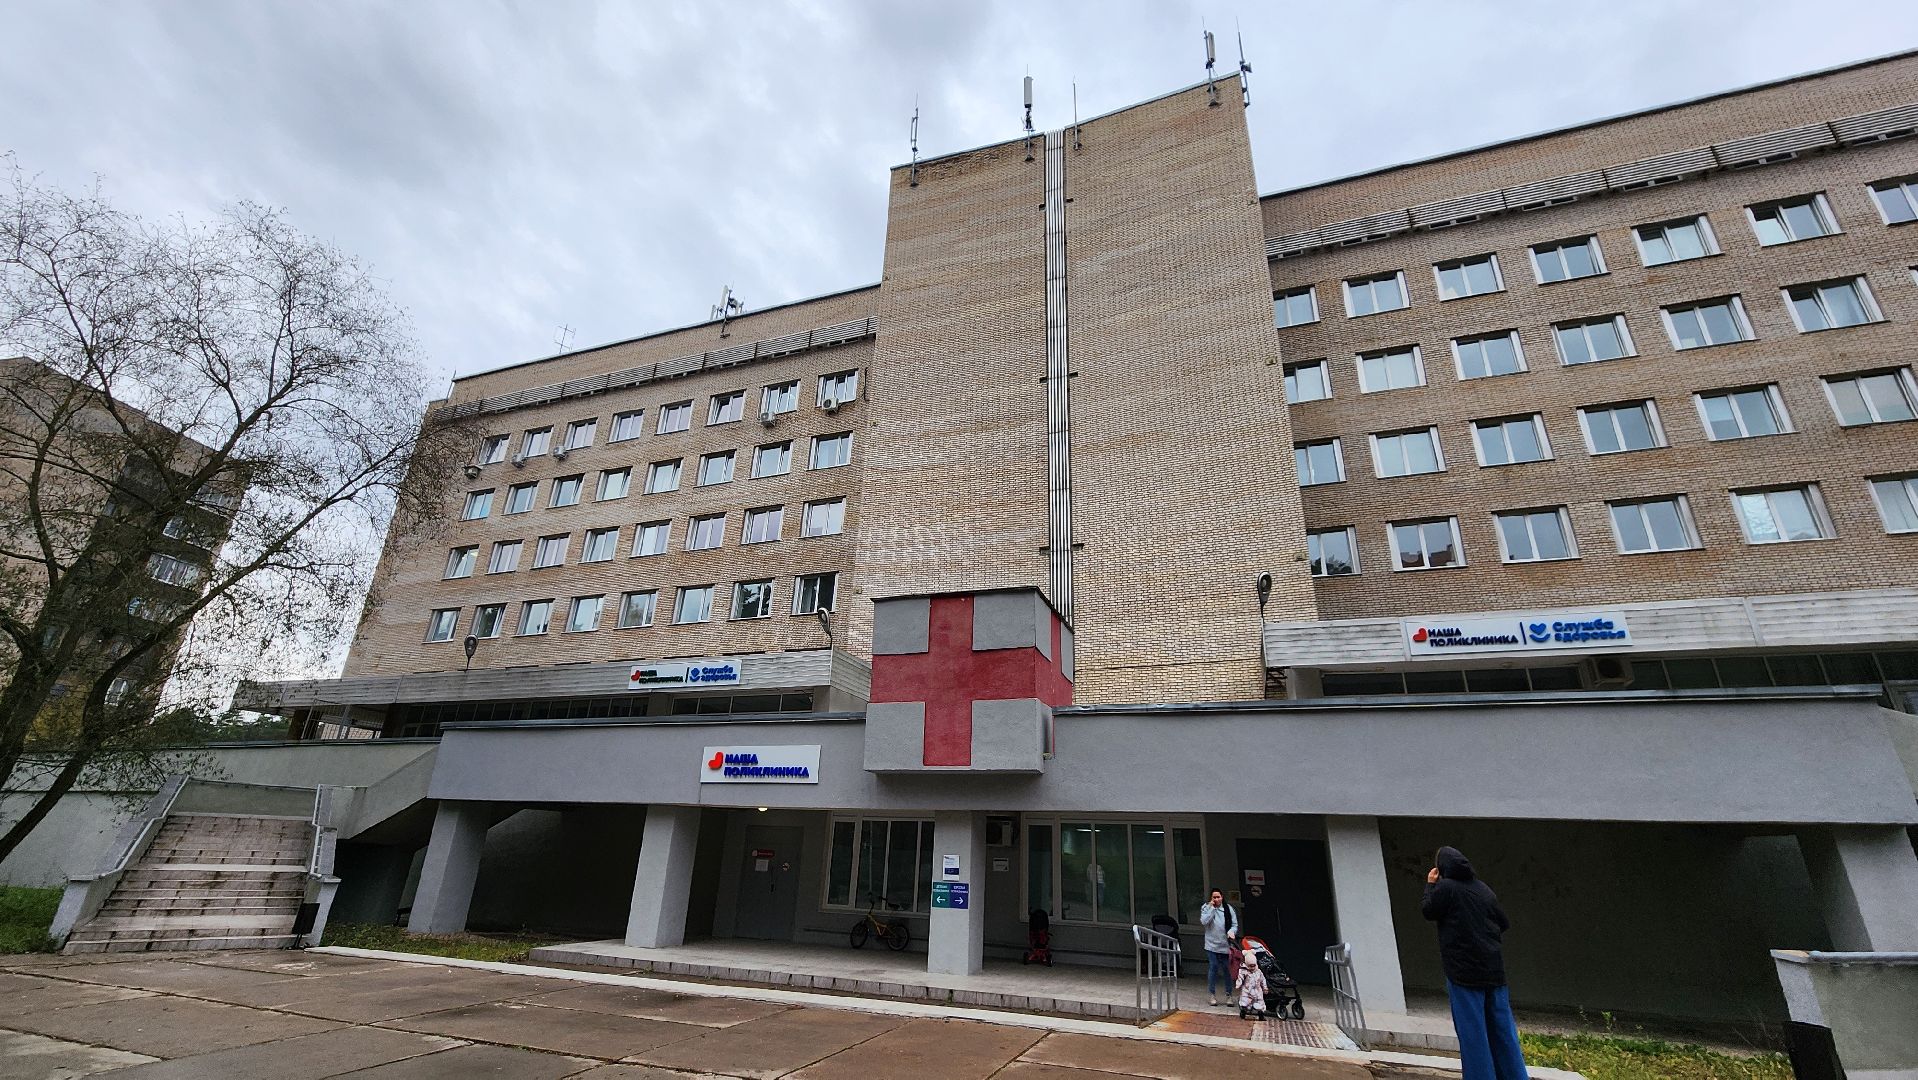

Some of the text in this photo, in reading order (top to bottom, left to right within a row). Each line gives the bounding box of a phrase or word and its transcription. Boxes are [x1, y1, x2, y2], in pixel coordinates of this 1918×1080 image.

[1552, 619, 1614, 632] Служба
[1428, 627, 1462, 638] НАША
[1554, 630, 1626, 643] здоровья
[1430, 635, 1519, 647] ПОЛИКЛИНИКА
[702, 665, 733, 675] Служба
[725, 753, 758, 765] НАША
[723, 766, 810, 778] ПОЛИКЛИНИКА
